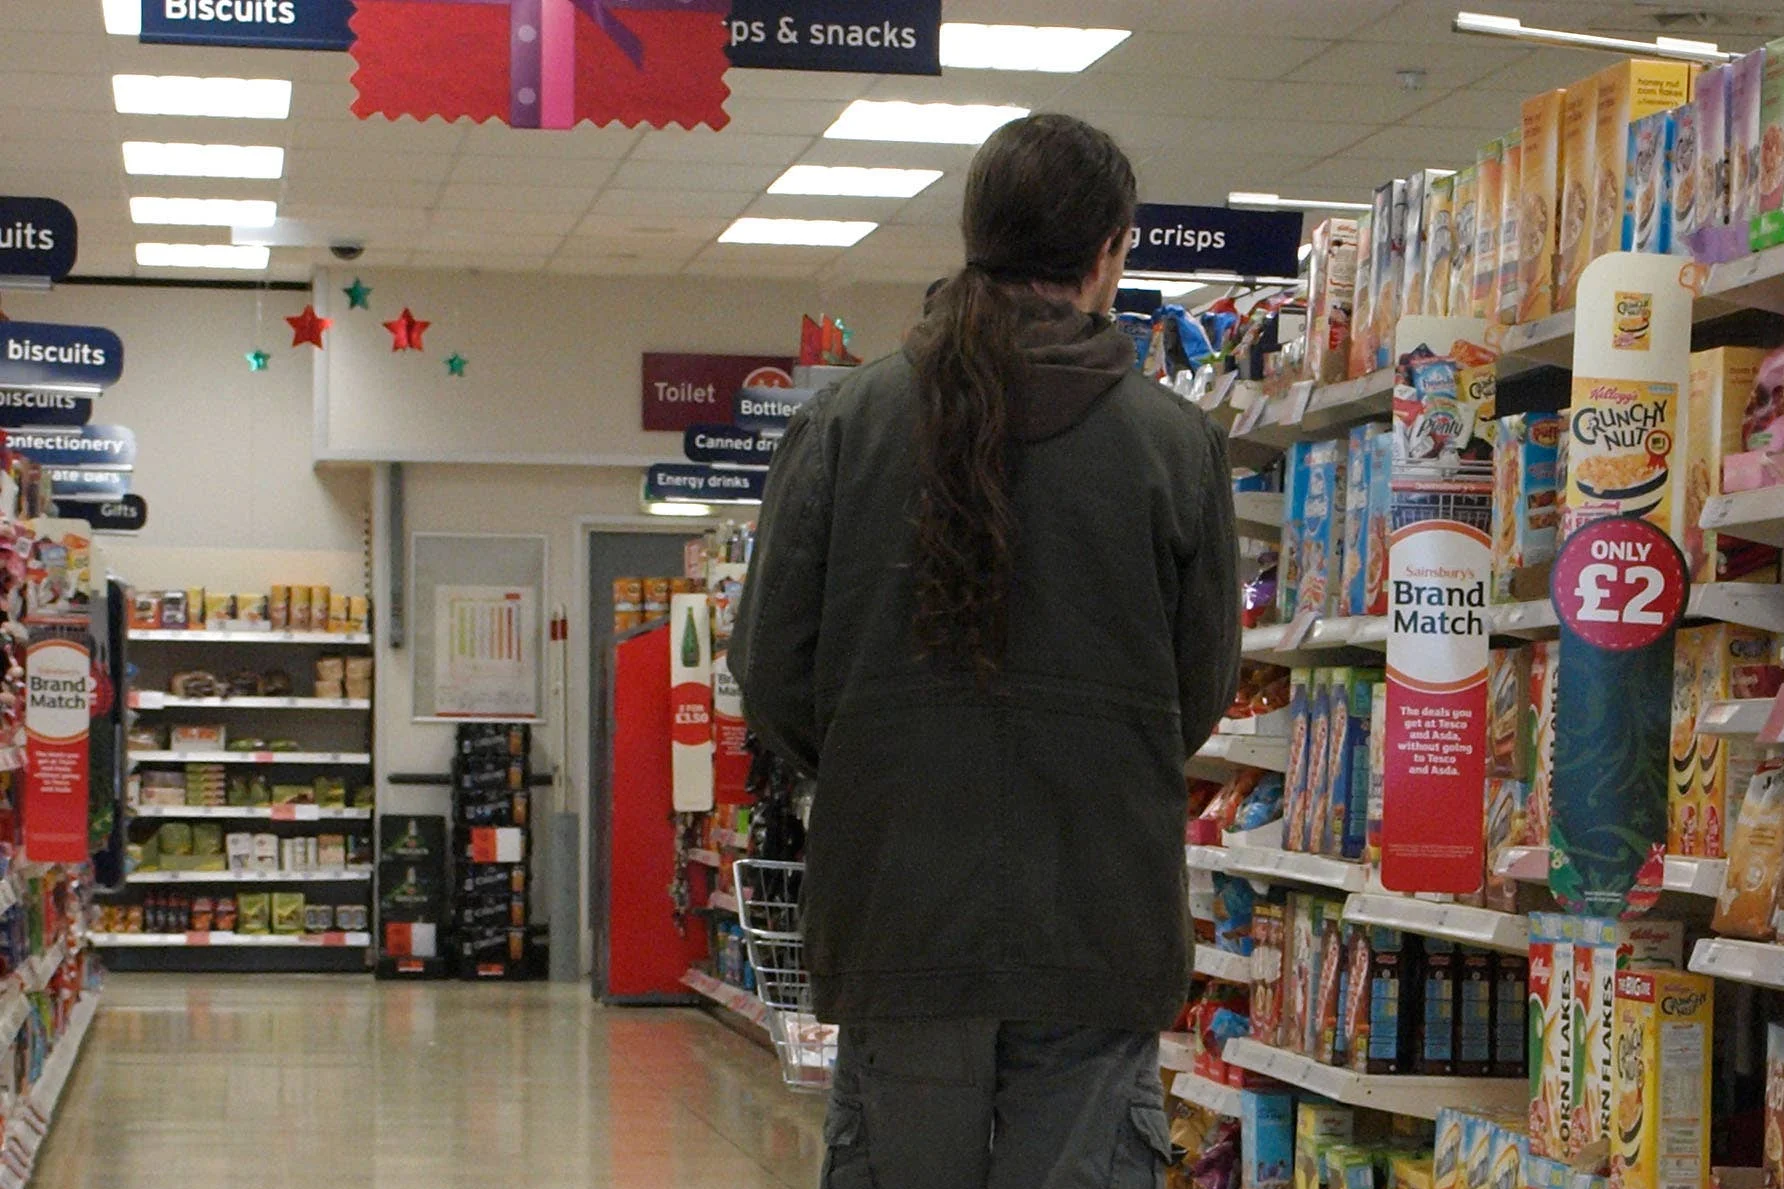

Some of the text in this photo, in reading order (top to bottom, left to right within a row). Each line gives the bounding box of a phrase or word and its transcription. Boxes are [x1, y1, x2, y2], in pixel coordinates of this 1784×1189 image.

[164, 0, 296, 25] Biscuits
[722, 17, 917, 50] ps & snacks
[1637, 78, 1663, 89] honey
[1150, 225, 1226, 252] crisps
[7, 339, 106, 366] biscuits
[655, 382, 716, 404] Toilet
[1589, 386, 1638, 405] Kellogg's
[1572, 400, 1668, 446] CRUNCHY
[695, 434, 752, 452] Canned
[1603, 429, 1648, 451] NUT
[657, 472, 750, 491] Energy drinks
[1590, 541, 1652, 563] ONLY
[1405, 566, 1475, 581] Sainsbury's
[1393, 580, 1485, 608] Brand
[1574, 566, 1665, 624] £2
[1393, 609, 1484, 636] Match
[30, 677, 87, 694] Brand
[30, 693, 87, 710] Match
[1400, 706, 1472, 720] The deals you
[1404, 719, 1468, 730] get at Tesco
[1409, 730, 1430, 740] and
[1397, 741, 1473, 755] without going
[1414, 753, 1456, 764] to Tesco
[1408, 764, 1429, 775] and
[1627, 976, 1642, 997] BIG
[1560, 969, 1572, 1073] FLAKES
[1600, 975, 1612, 1089] FLAKES
